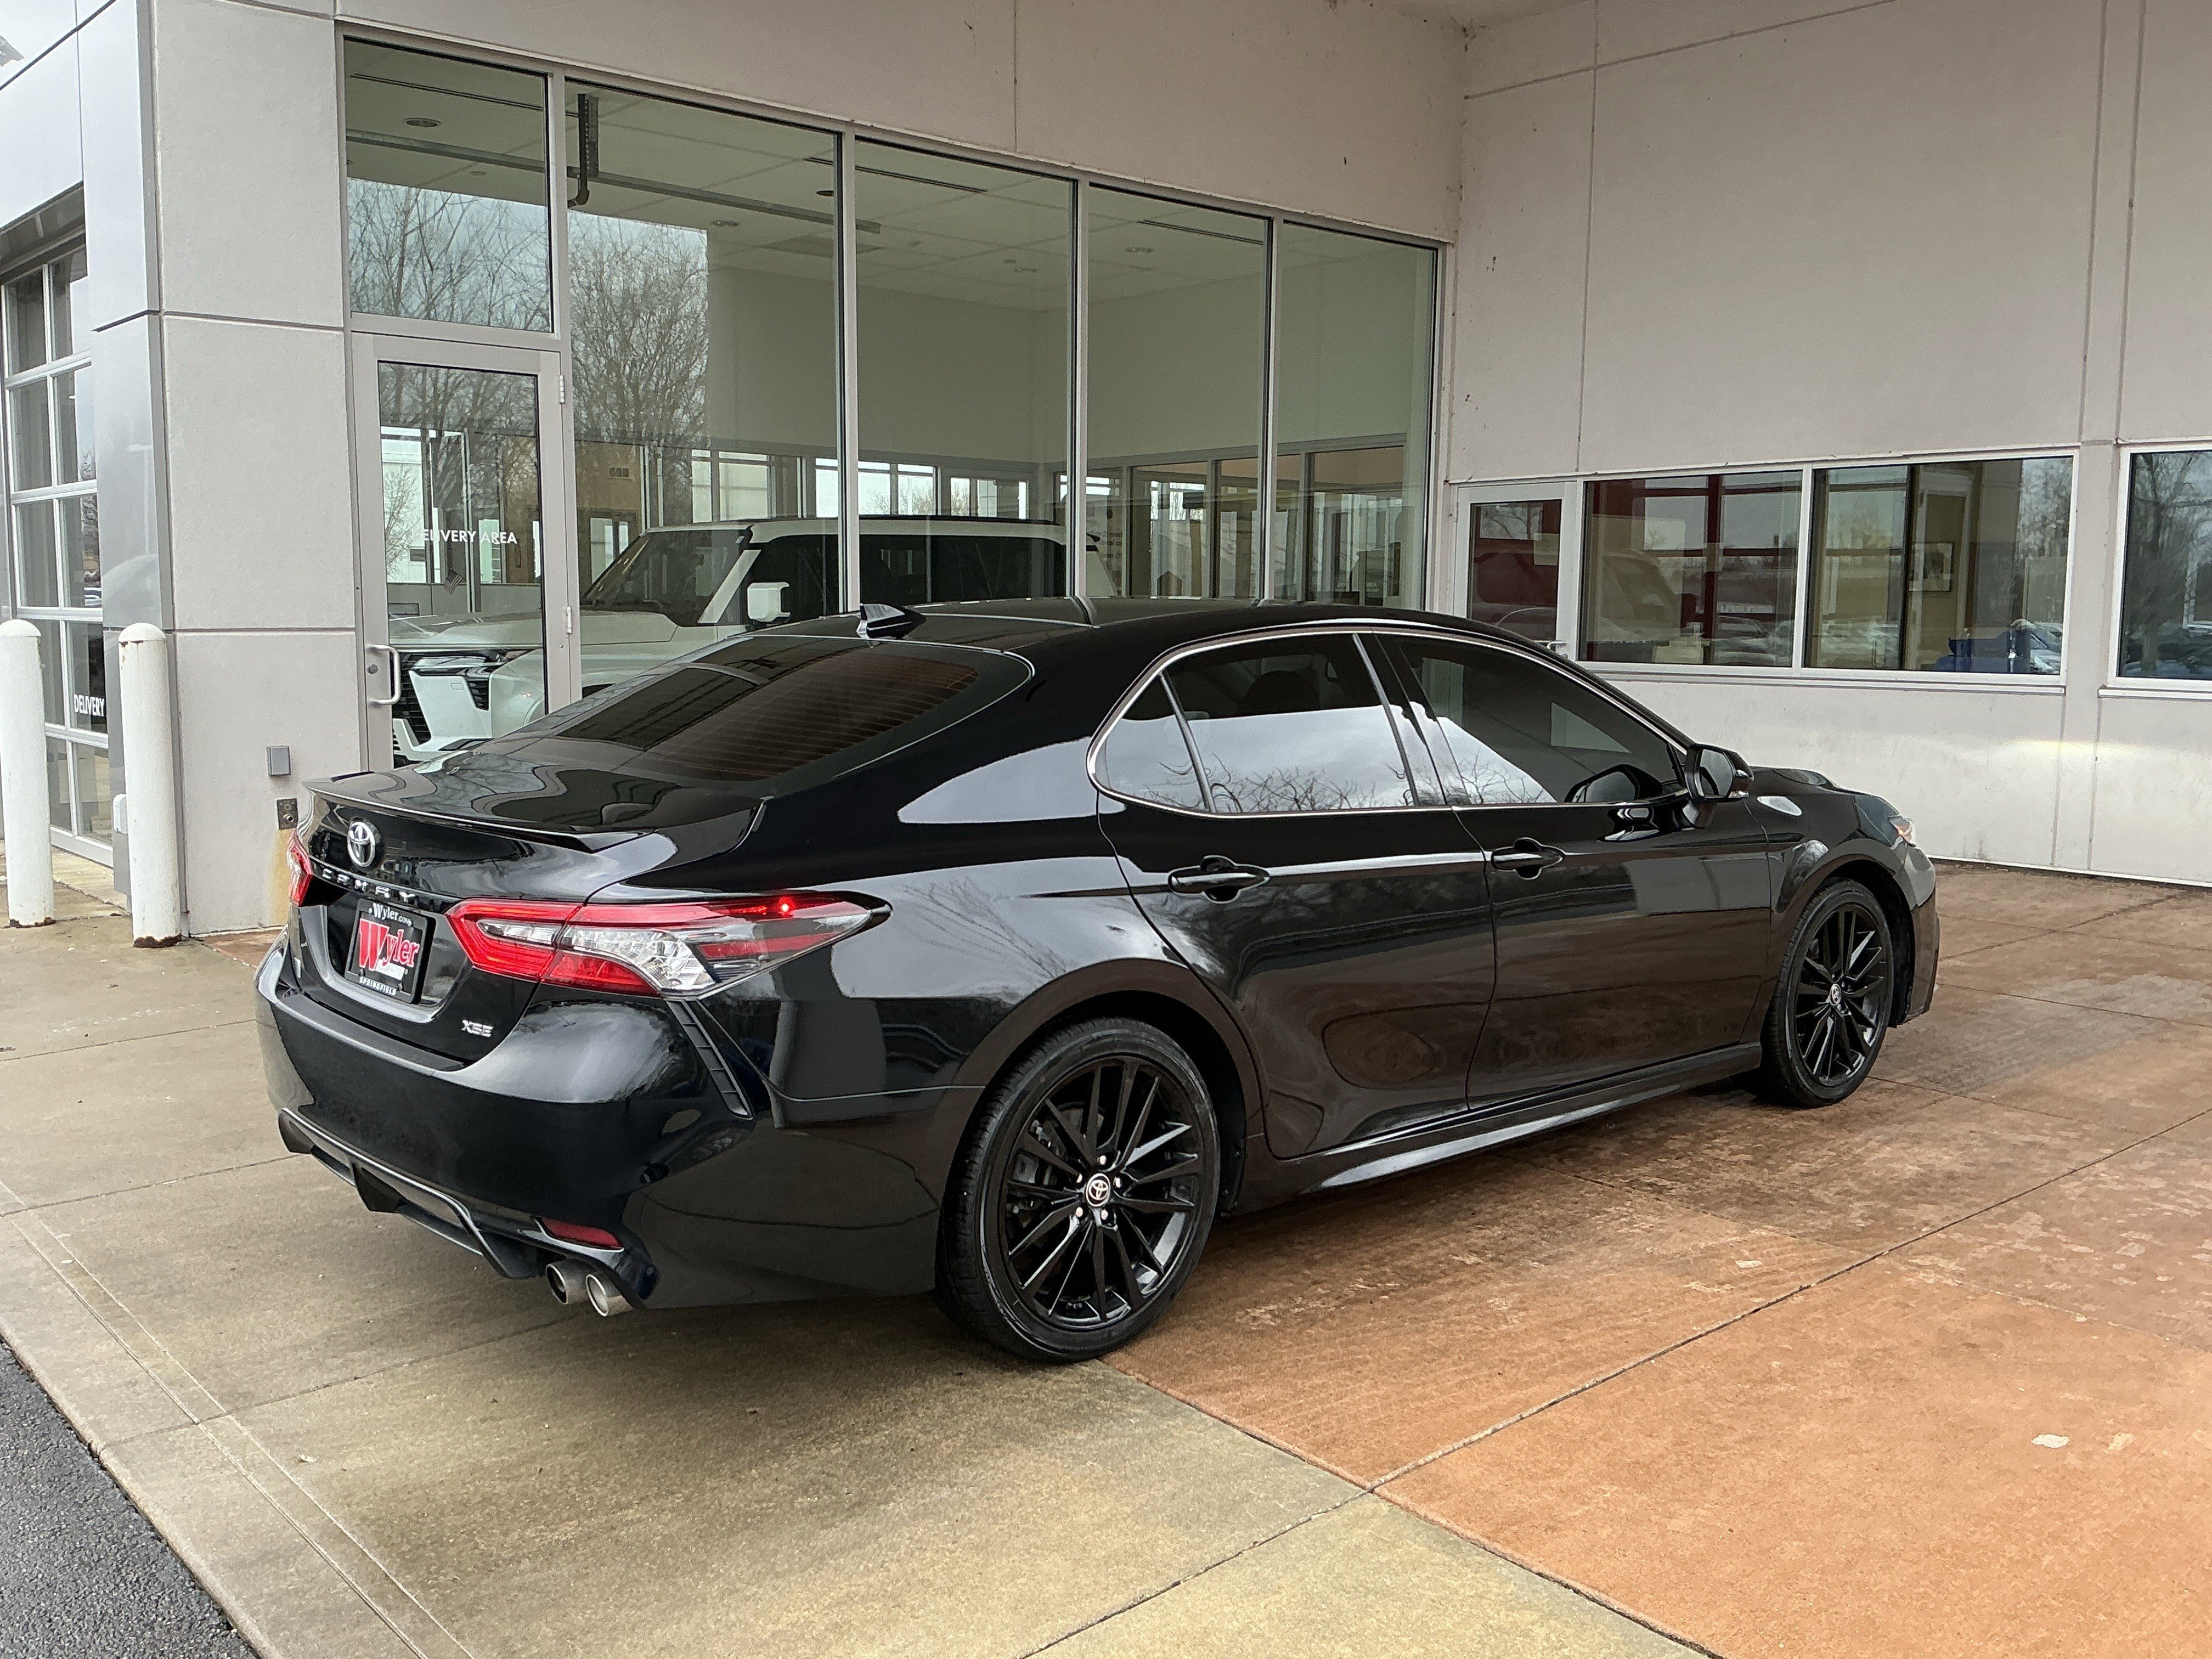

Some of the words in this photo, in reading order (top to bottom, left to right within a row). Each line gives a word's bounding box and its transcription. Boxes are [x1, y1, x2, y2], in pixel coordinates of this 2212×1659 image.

[481, 531, 517, 544] AREA
[74, 694, 104, 716] DELIVERY
[322, 868, 415, 902] CAMRY
[373, 902, 411, 926] Wyler.com
[359, 918, 420, 971] Wyler
[359, 977, 396, 996] SPRINGFIELD
[461, 1020, 494, 1037] XSE
